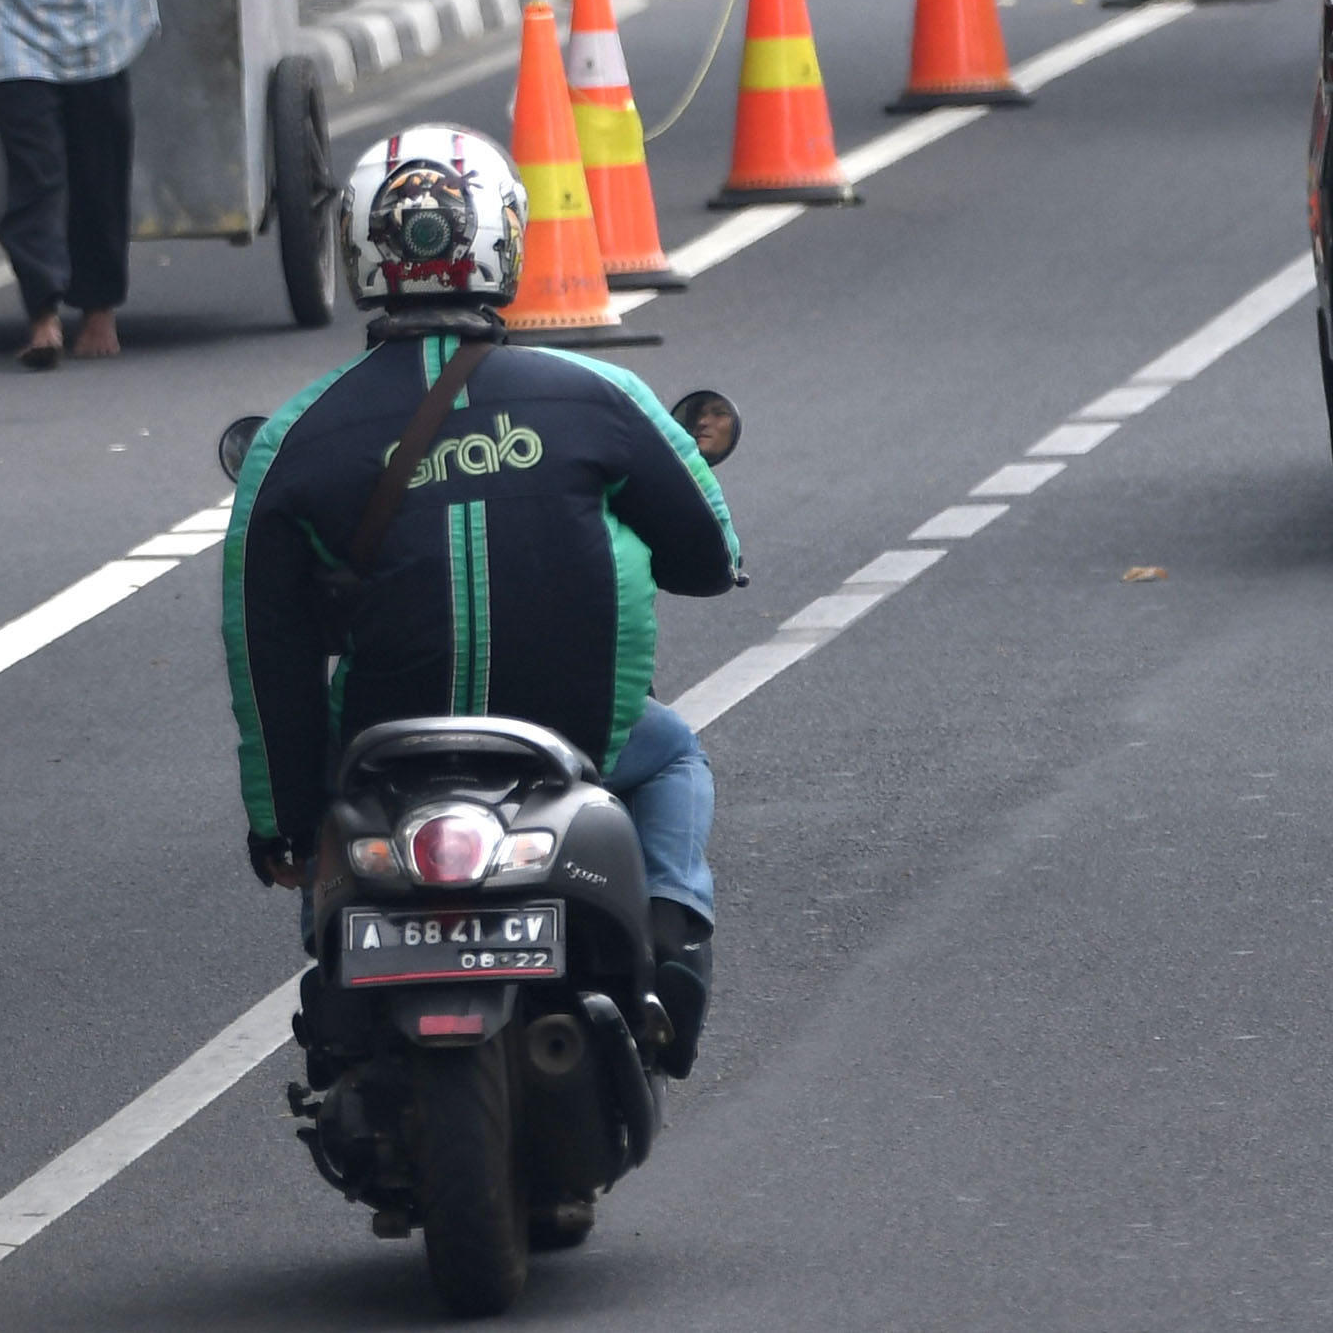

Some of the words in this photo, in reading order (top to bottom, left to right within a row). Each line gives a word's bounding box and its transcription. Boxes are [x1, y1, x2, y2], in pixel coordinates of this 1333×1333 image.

[362, 923, 381, 949] A
[404, 919, 484, 946] 6841
[504, 916, 543, 942] CV
